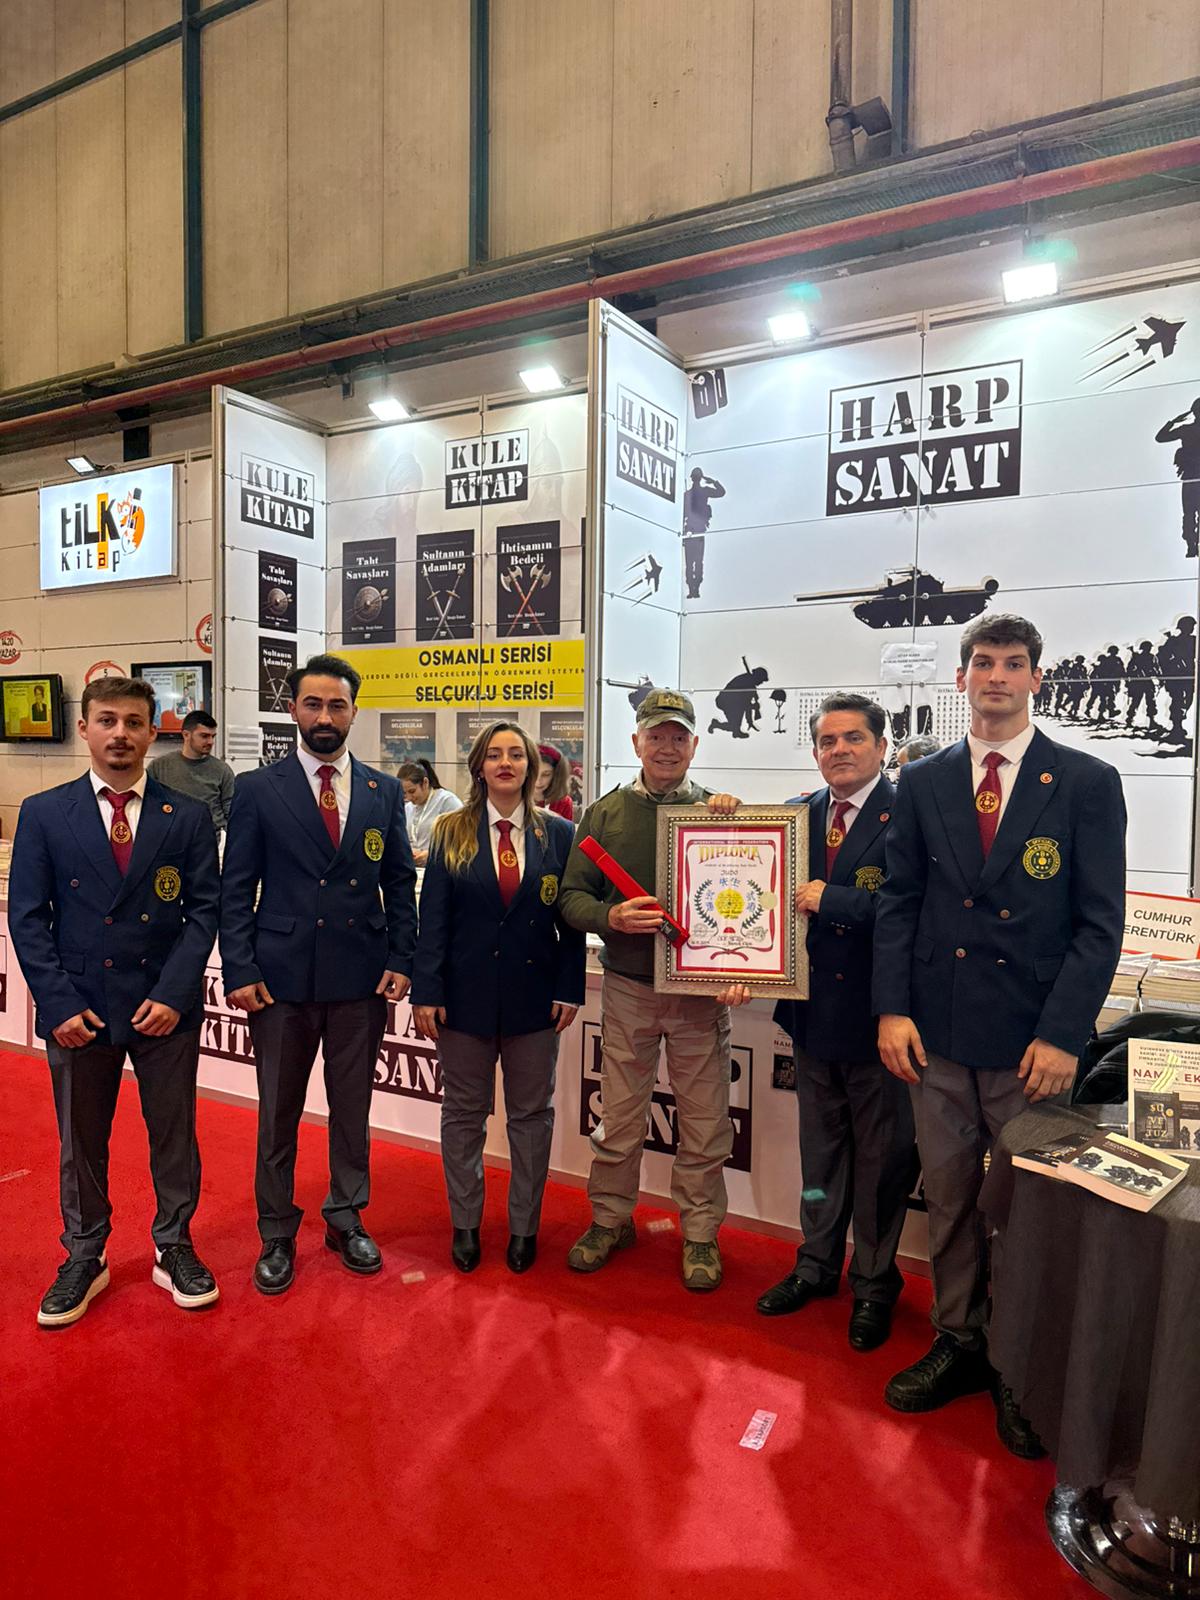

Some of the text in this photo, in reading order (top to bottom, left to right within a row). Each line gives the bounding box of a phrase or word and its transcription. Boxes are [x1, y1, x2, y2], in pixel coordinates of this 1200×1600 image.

[839, 376, 1010, 444] HARP
[620, 394, 675, 451] HARP
[450, 437, 521, 470] KULE
[618, 440, 675, 495] SANAT
[834, 441, 1009, 507] SANAT
[246, 459, 309, 502] KULE
[450, 469, 524, 504] KİTAP
[246, 494, 311, 532] KİTAP
[422, 549, 466, 561] Sultanın
[500, 541, 553, 555] İhtişamın
[510, 552, 545, 566] Bedeli
[269, 565, 285, 575] Taht
[356, 556, 380, 567] Taht
[421, 561, 467, 574] Adamları
[345, 569, 390, 582] Savaşları
[262, 649, 292, 659] Sultanın
[418, 642, 552, 667] OSMANLI SERİSİ
[361, 672, 391, 681] LERDEN
[415, 680, 554, 704] SELÇUKLU SERİSİ
[698, 846, 764, 865] DIPLOMA
[1133, 909, 1192, 926] CUMHUR
[1123, 924, 1196, 944] ERENTÜRK
[200, 1016, 255, 1058] KİT
[373, 1048, 445, 1096] SAN
